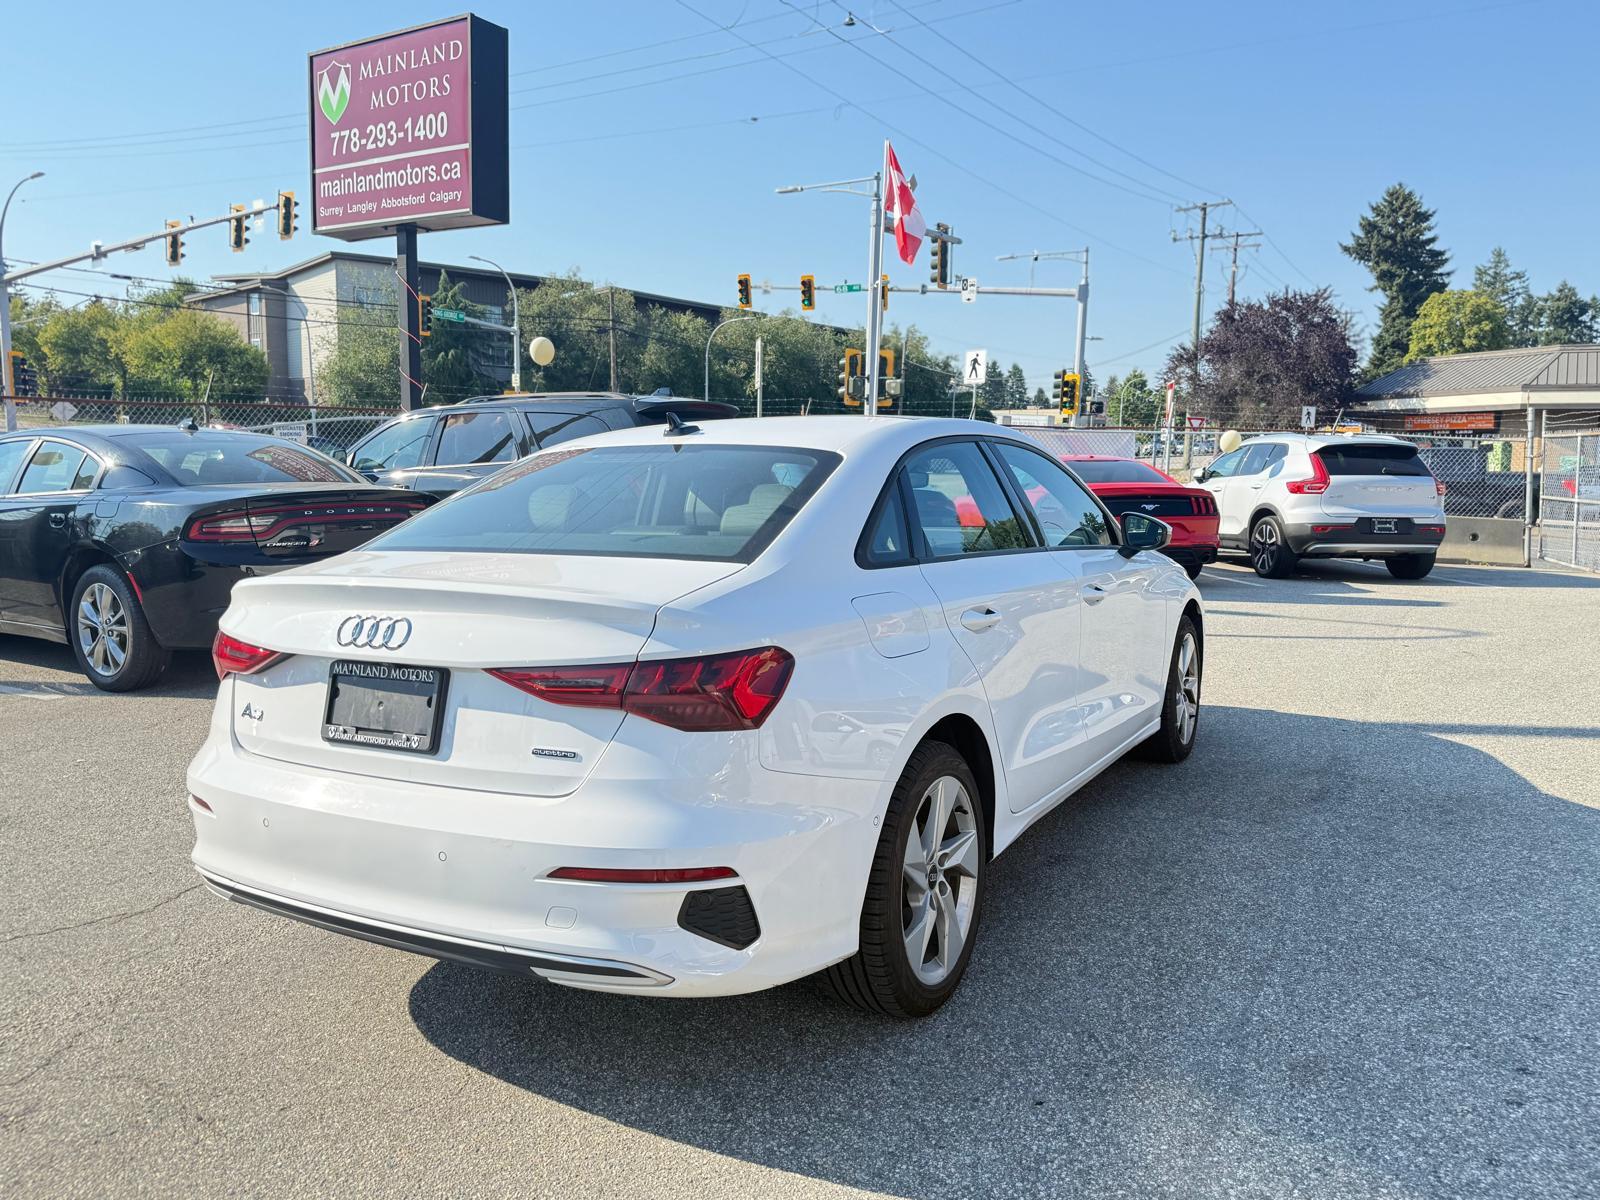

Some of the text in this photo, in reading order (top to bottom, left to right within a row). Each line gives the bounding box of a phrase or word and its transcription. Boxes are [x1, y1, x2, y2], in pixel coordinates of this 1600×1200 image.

[359, 40, 463, 80] MAINLAND
[370, 74, 451, 110] MOTORS
[330, 111, 448, 157] 778-293-1400
[320, 161, 461, 198] mainlandmotors.ca
[319, 189, 462, 217] Surrey Langley Abbotsford Calgary
[333, 663, 434, 682] MAINLAND MOTORS
[533, 749, 574, 758] quattro
